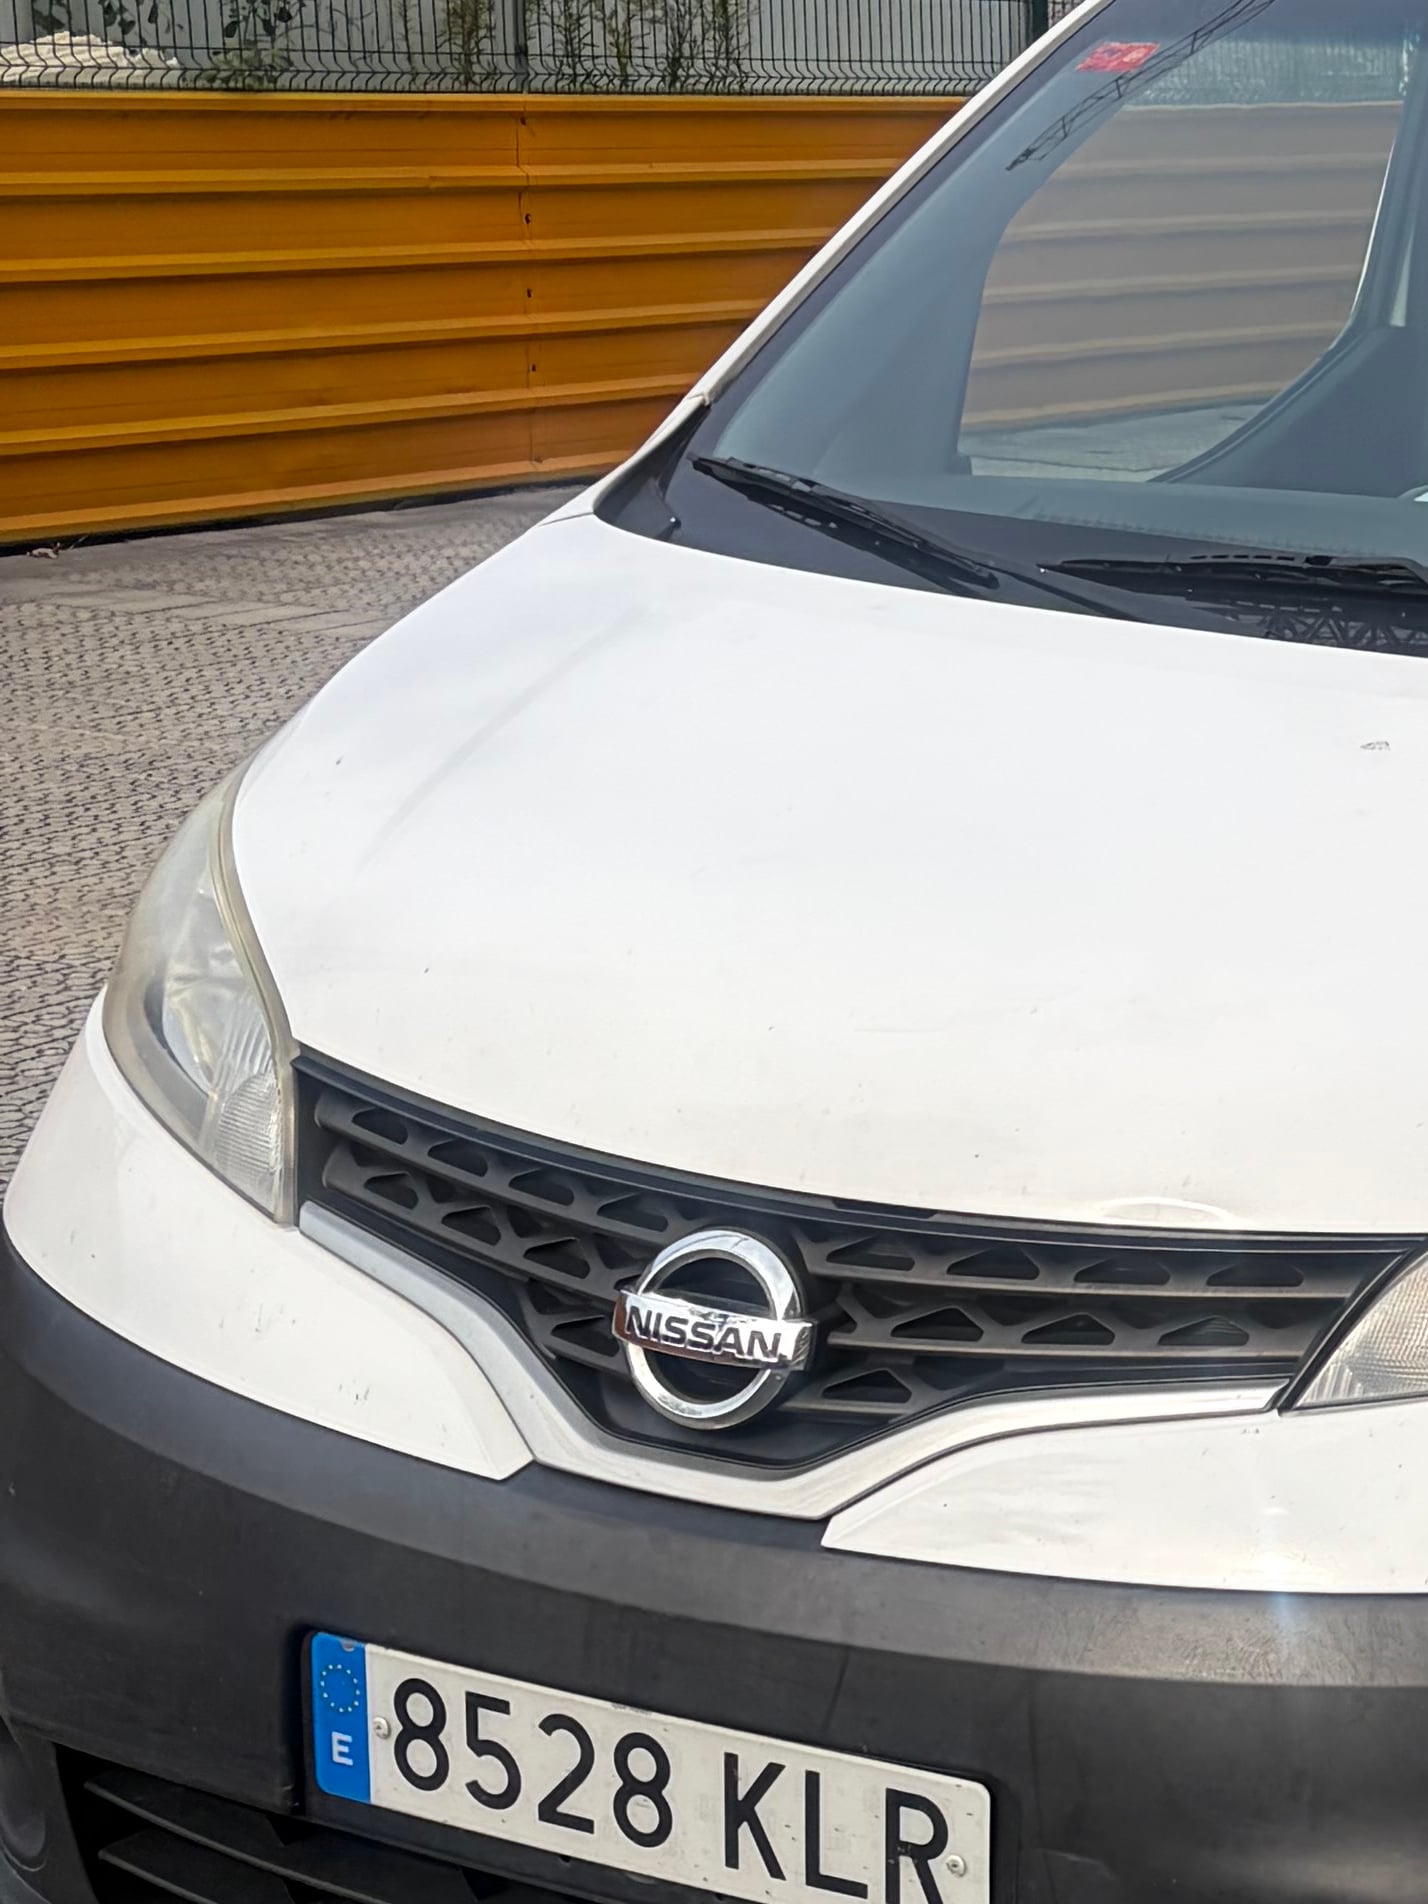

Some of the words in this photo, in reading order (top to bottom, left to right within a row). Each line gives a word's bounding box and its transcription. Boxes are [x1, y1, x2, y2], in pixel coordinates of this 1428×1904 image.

[625, 1305, 782, 1360] NISSAN
[331, 1730, 354, 1766] E
[393, 1677, 674, 1848] 8528
